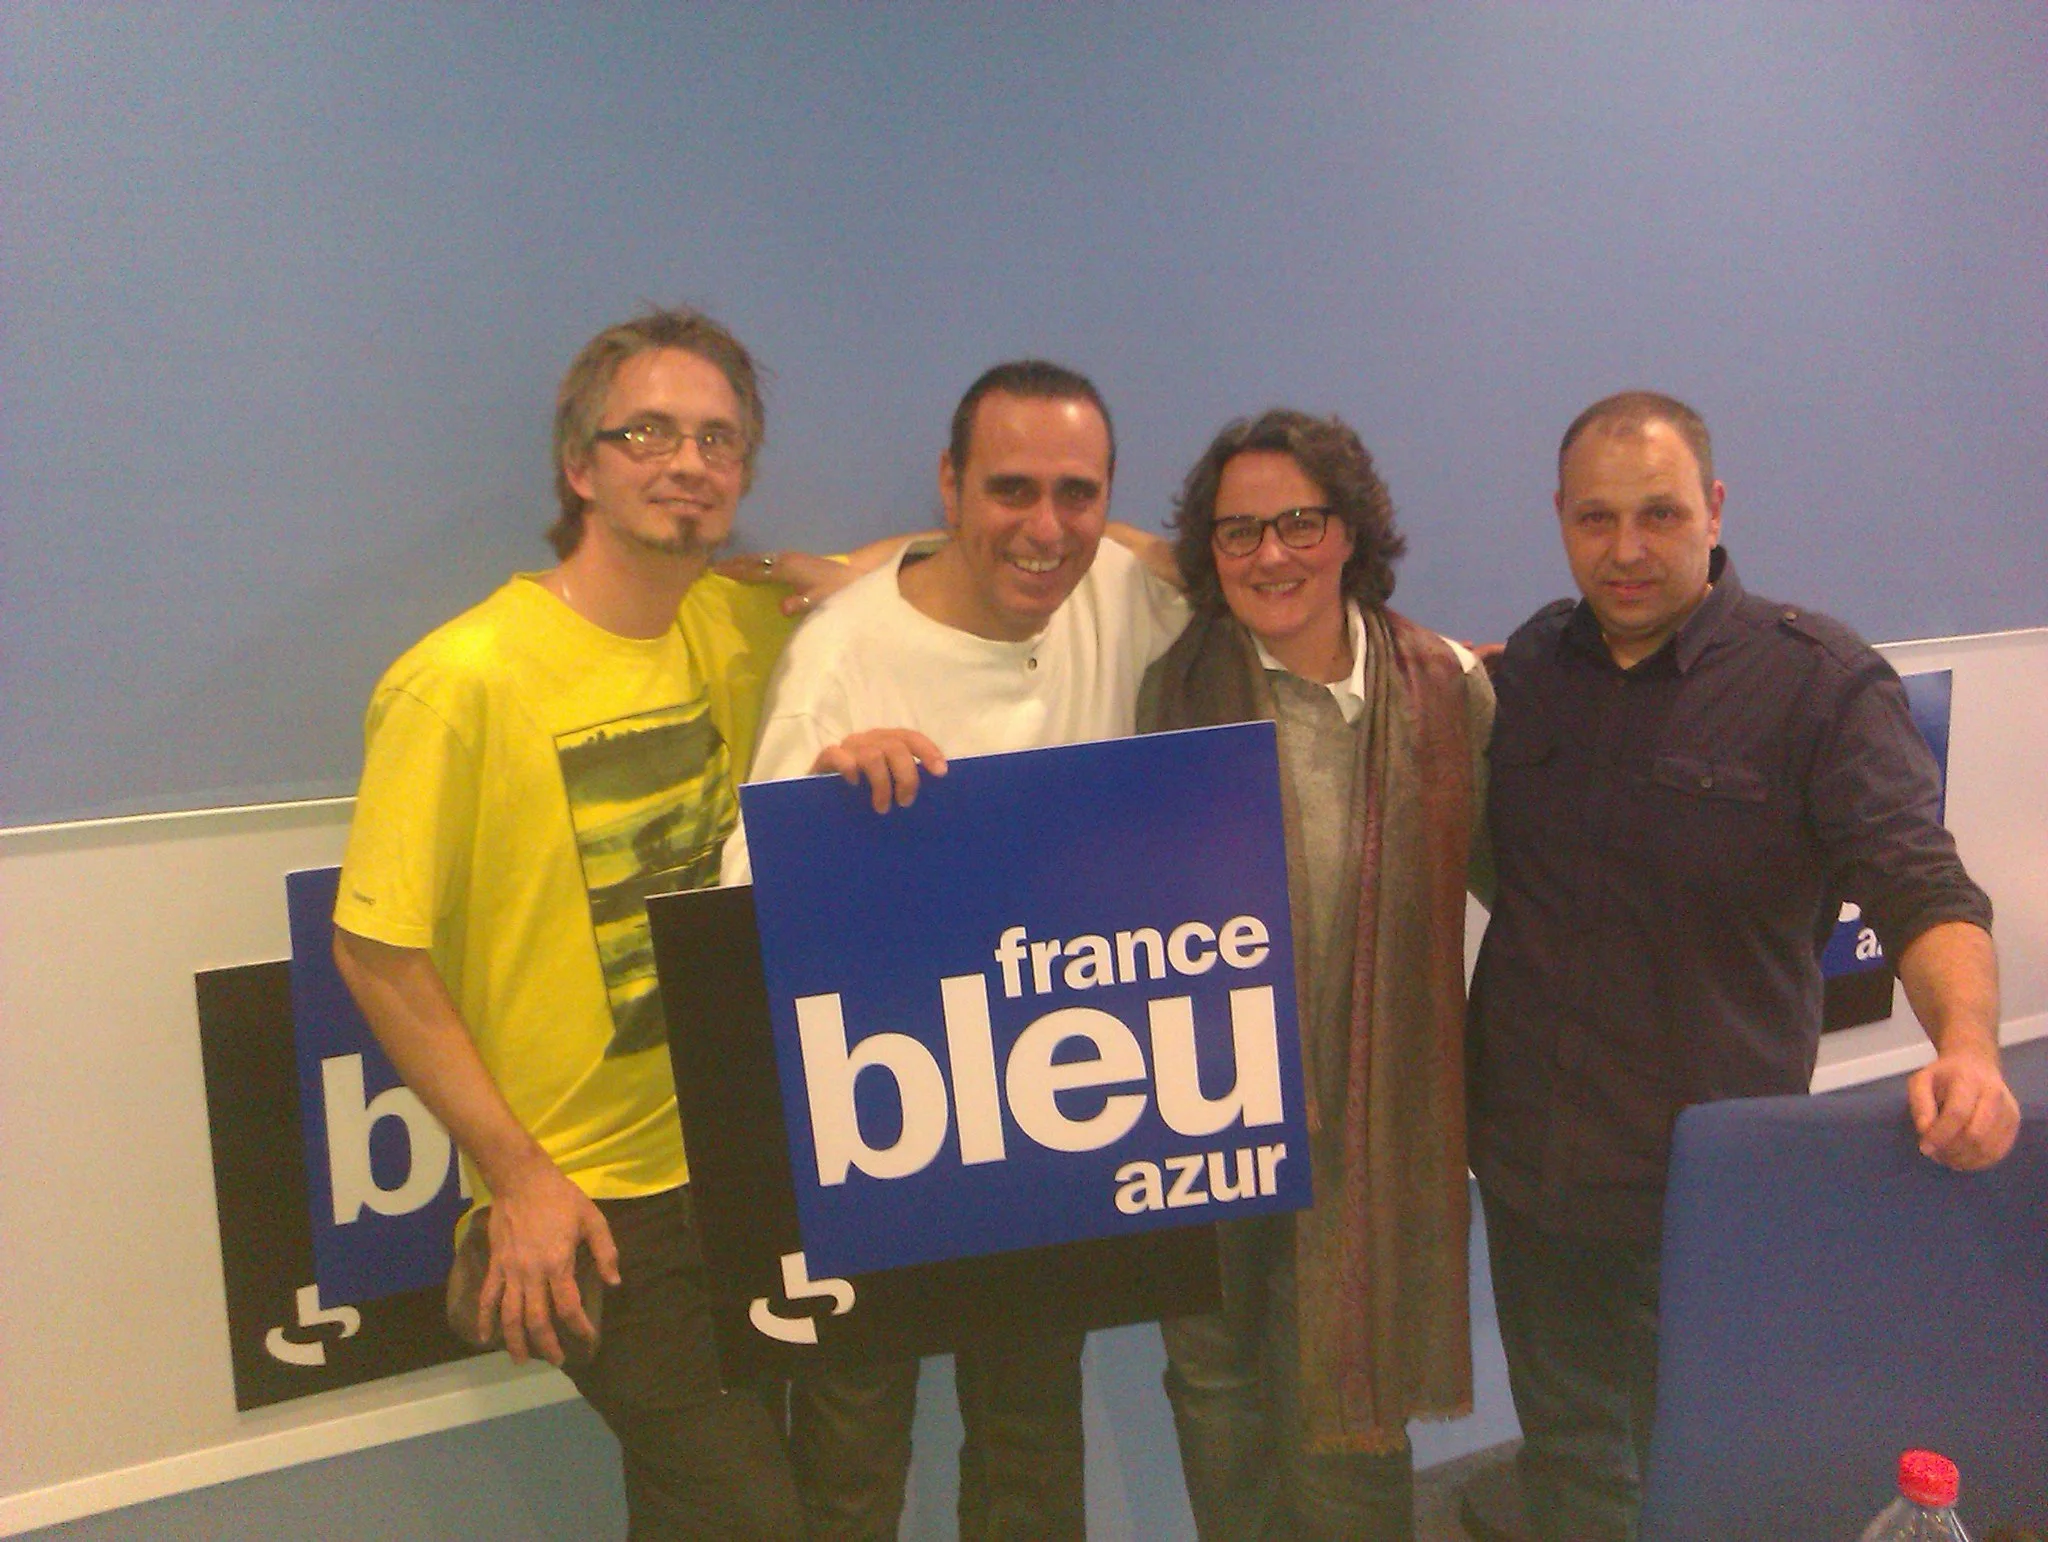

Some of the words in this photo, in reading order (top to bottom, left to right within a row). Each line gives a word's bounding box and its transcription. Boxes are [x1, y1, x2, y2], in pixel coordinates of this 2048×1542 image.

[994, 914, 1270, 998] france
[1856, 927, 1883, 961] a
[795, 973, 1284, 1187] bleu
[321, 1053, 473, 1226] b
[1113, 1143, 1288, 1215] azur
